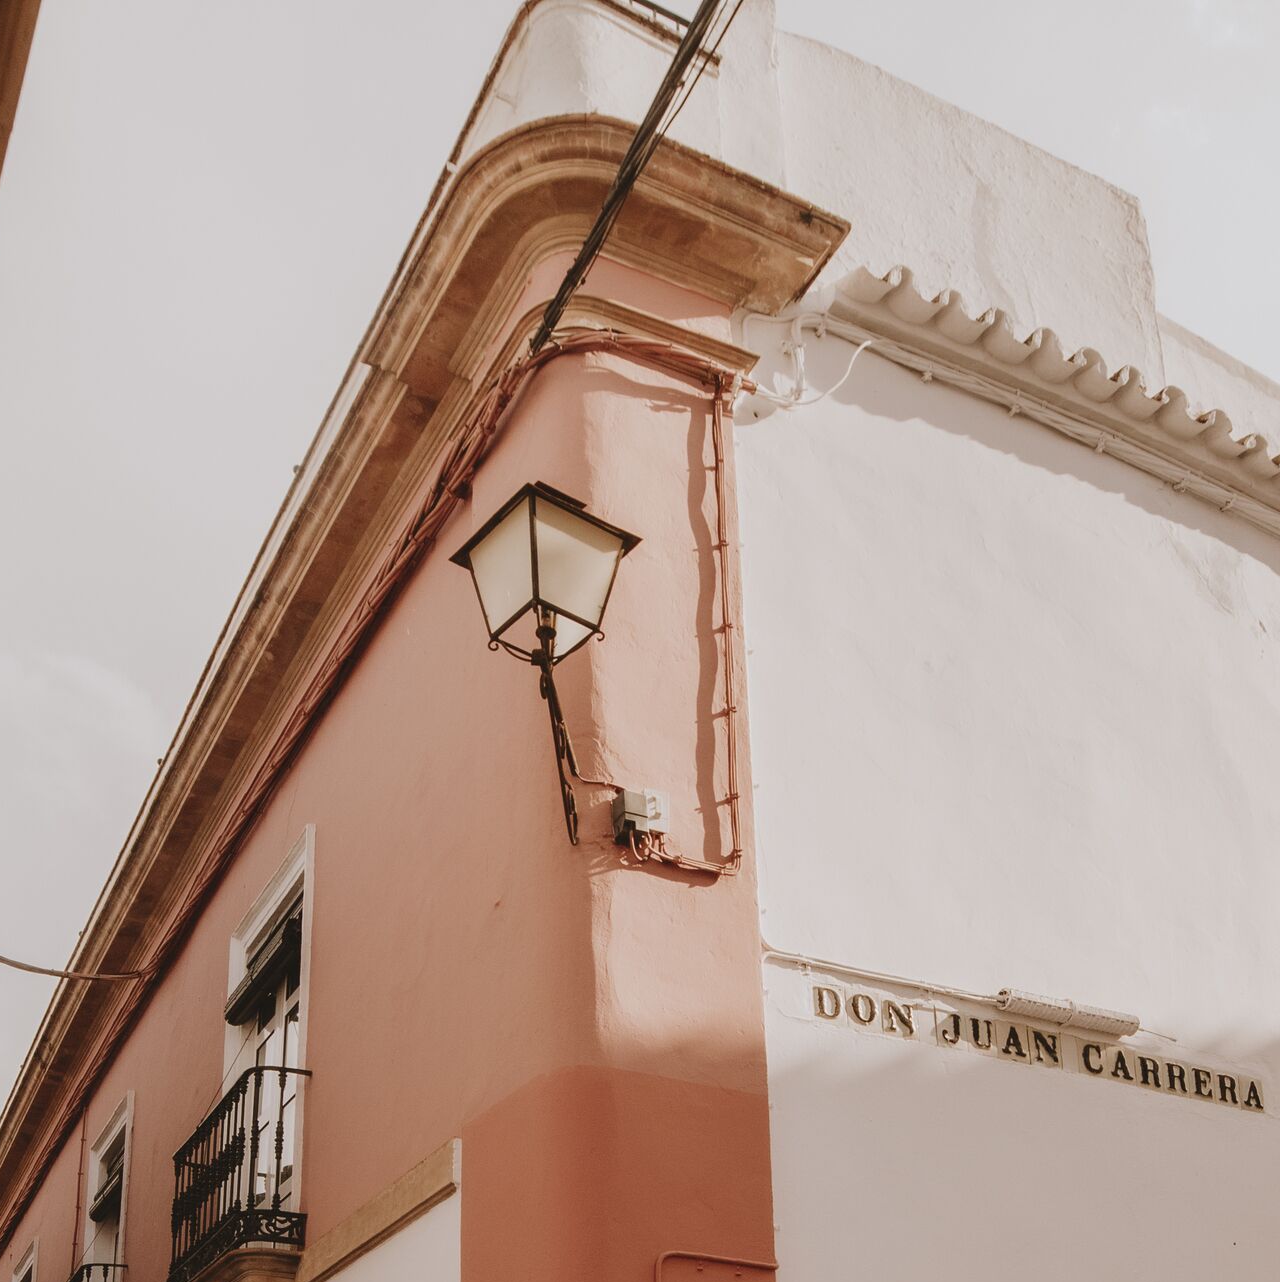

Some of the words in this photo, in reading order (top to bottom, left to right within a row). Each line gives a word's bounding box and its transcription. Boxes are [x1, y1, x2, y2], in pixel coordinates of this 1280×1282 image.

[812, 986, 917, 1039] DON
[941, 1012, 1060, 1063] JUAN
[1081, 1043, 1265, 1110] CARRERA
